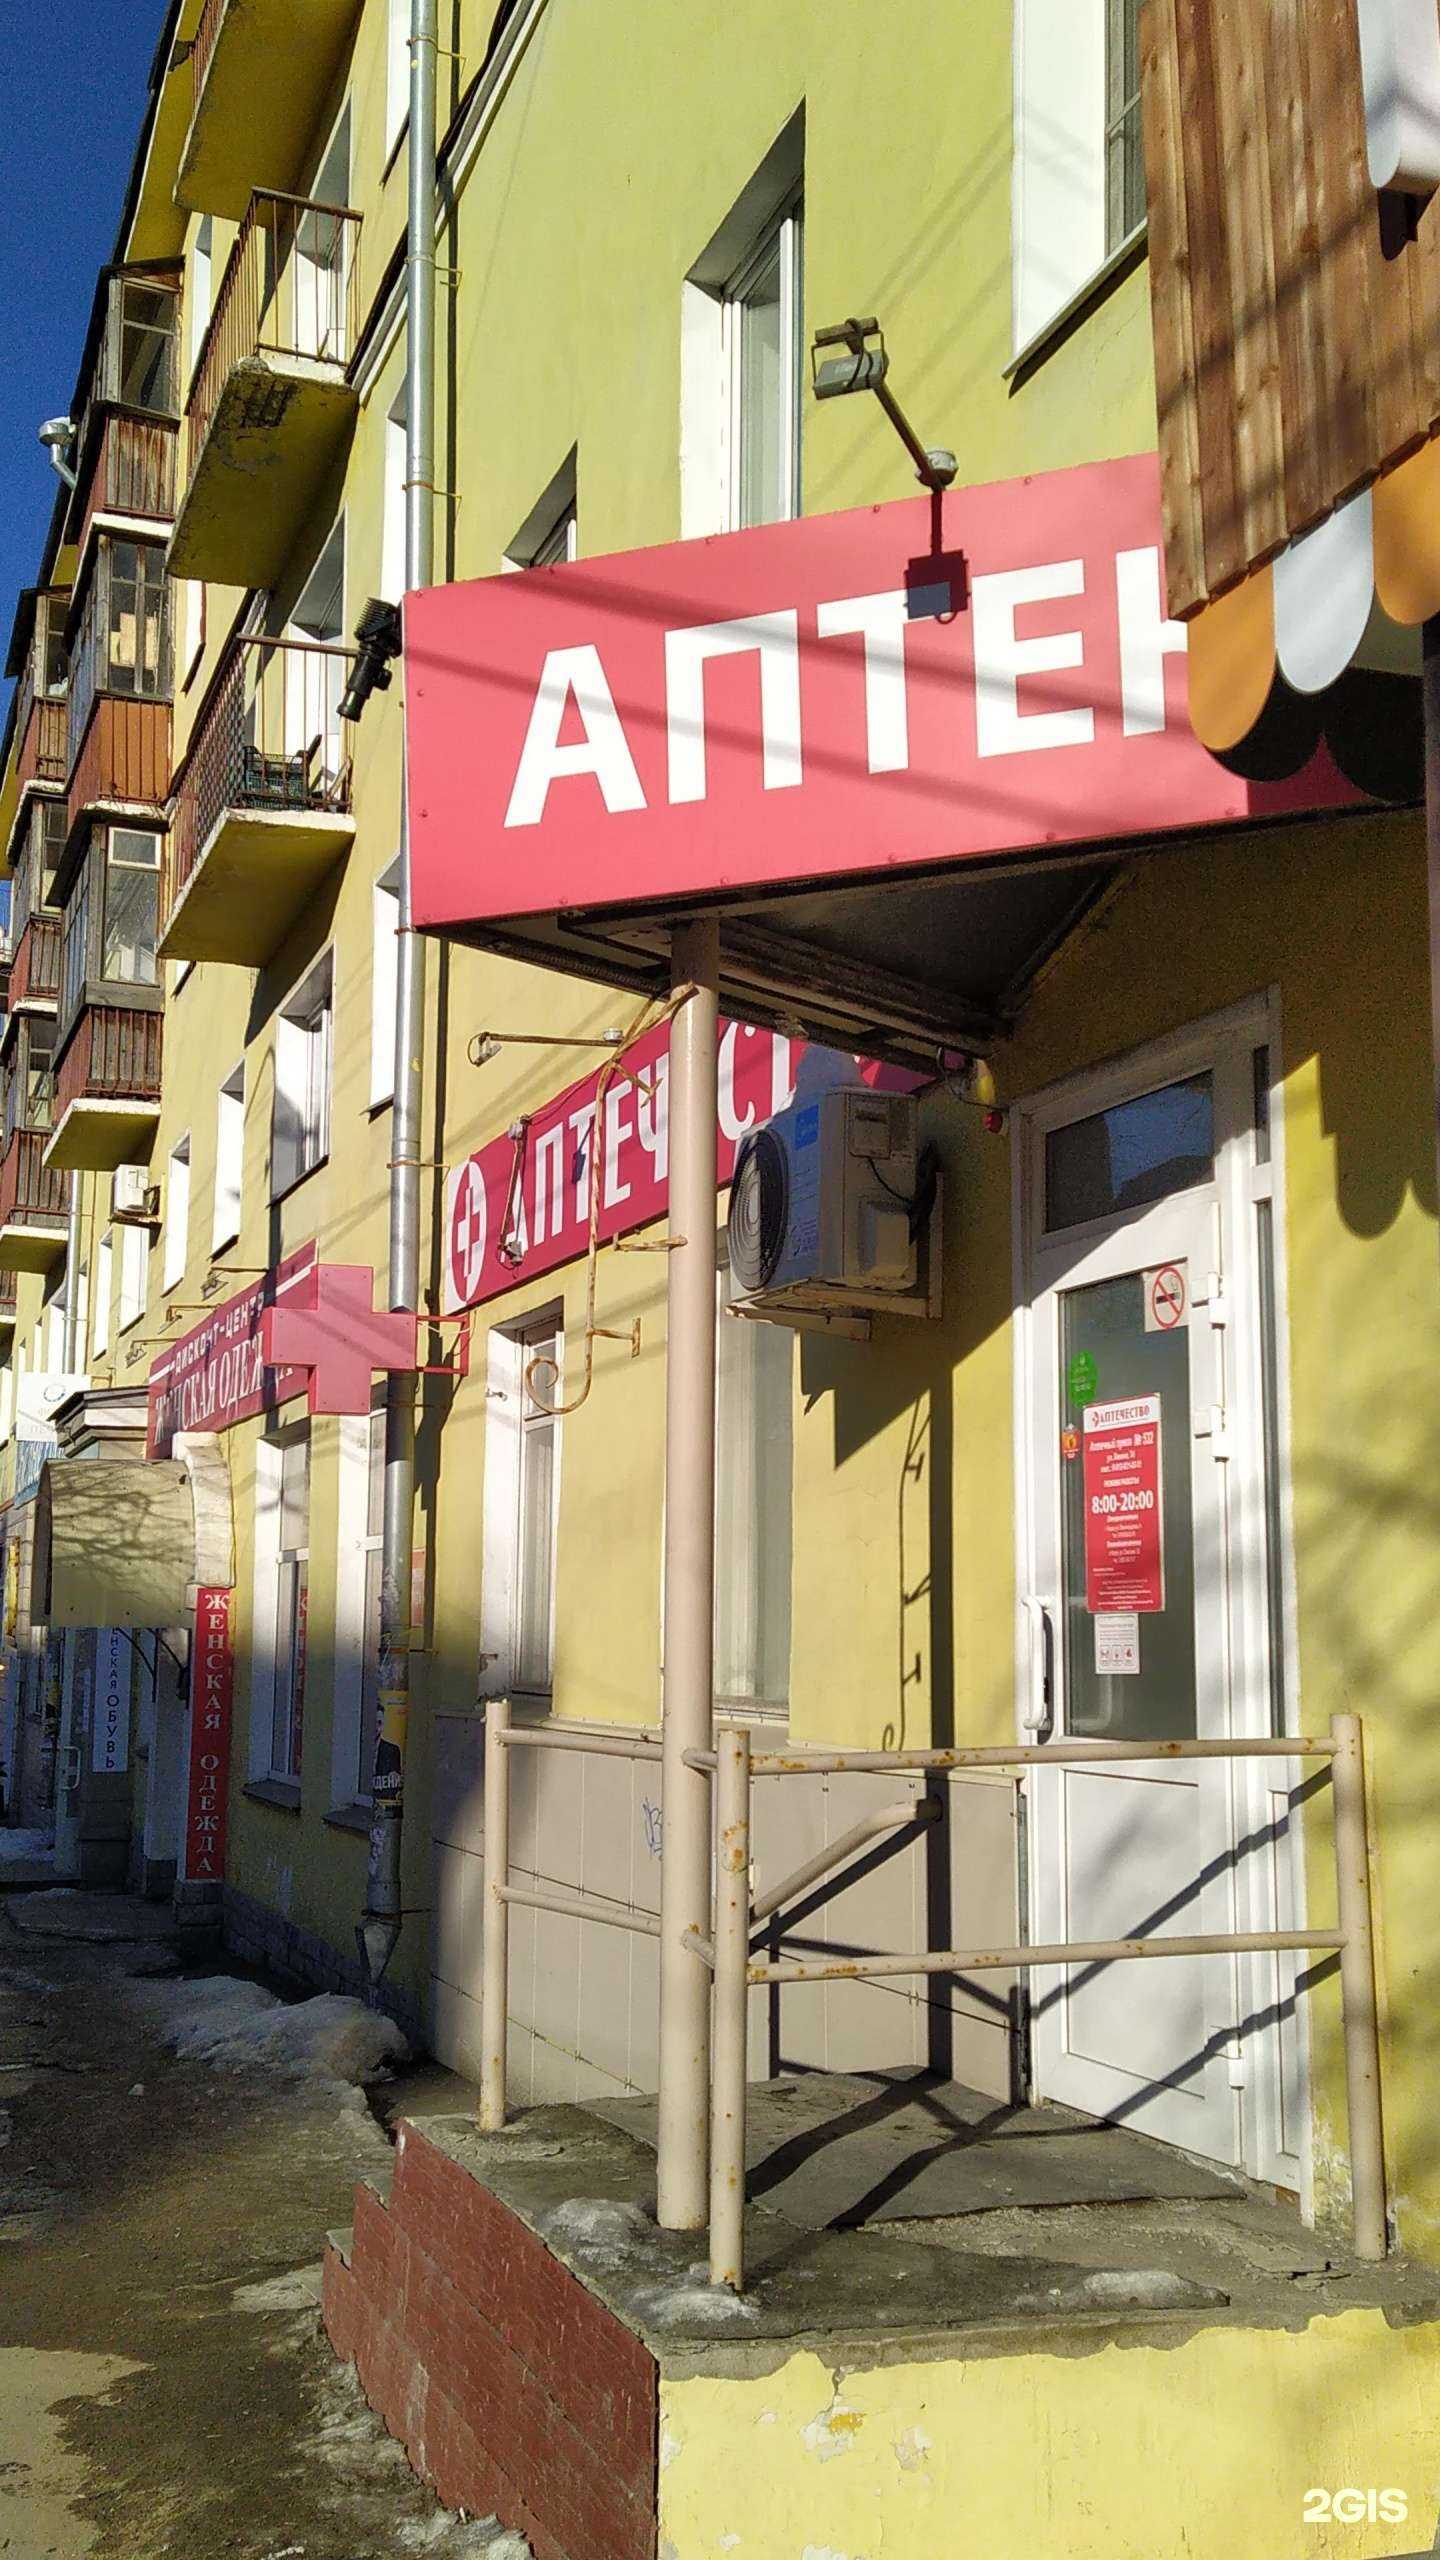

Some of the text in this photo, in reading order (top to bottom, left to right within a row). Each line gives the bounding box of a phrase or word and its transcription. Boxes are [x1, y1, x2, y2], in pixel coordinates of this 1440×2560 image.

[219, 1331, 294, 1421] ОДЕЖ
[1092, 1490, 1154, 1514] 8:00-20:00
[105, 1694, 120, 1769] ОБУВЬ
[195, 1594, 230, 1872] ЖЕНСКАЯ ОДЕЖДА
